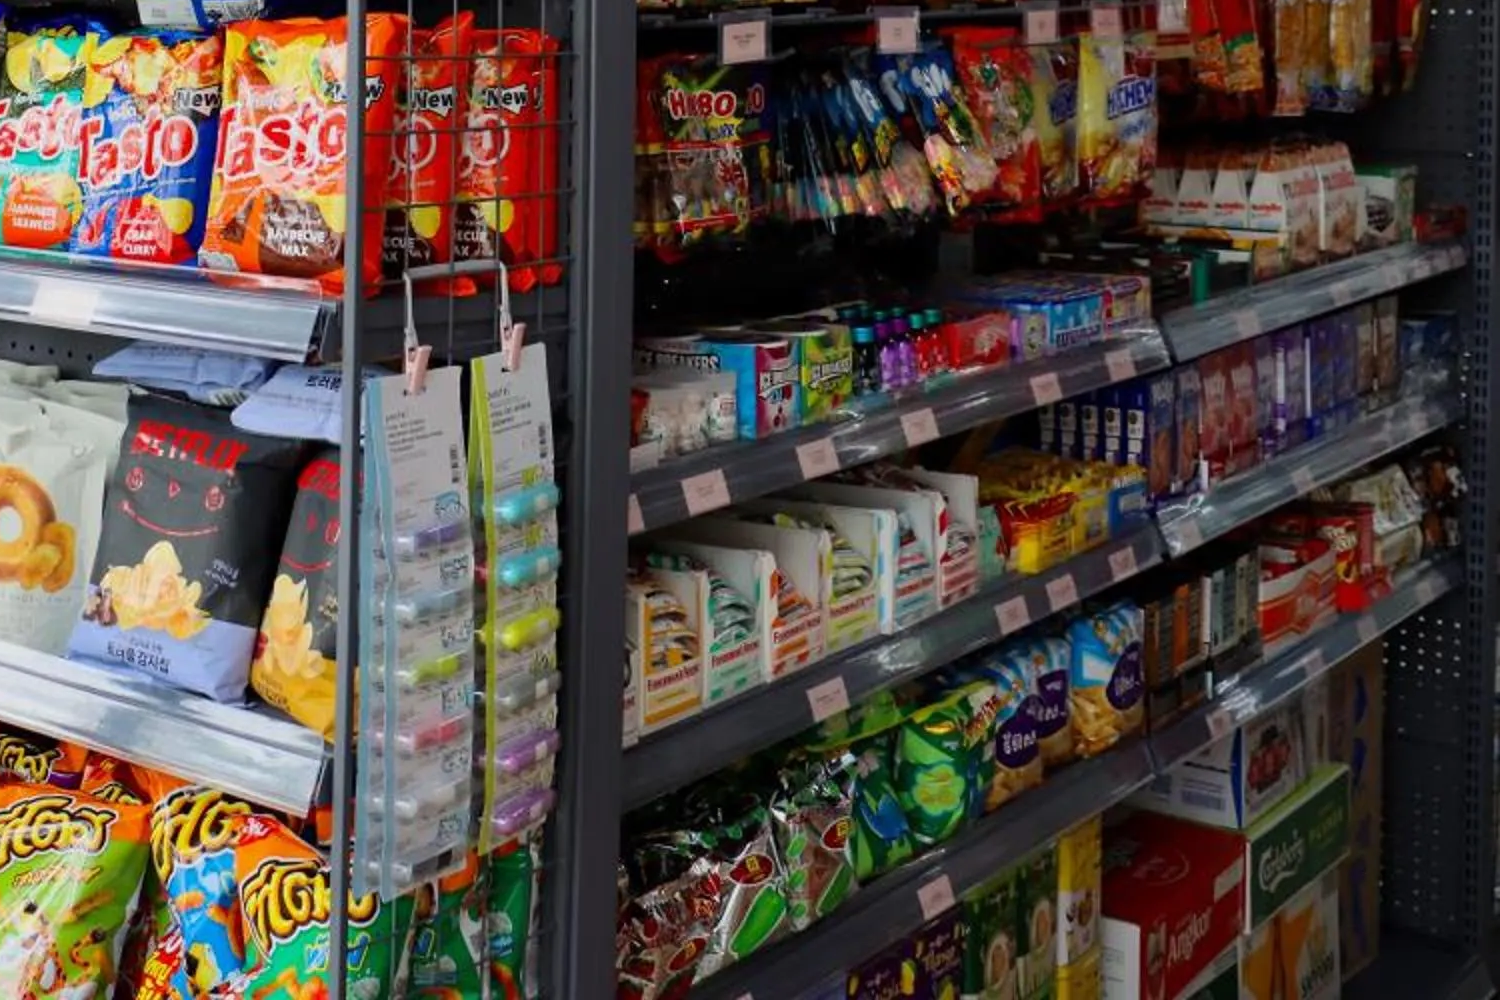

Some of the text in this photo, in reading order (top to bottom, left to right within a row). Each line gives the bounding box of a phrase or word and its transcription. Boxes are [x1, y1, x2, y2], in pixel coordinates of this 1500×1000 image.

[177, 89, 221, 108] New
[415, 90, 454, 109] New
[485, 87, 528, 106] New
[77, 104, 199, 189] Tasto
[214, 96, 347, 182] Tasto
[281, 244, 309, 257] MAX
